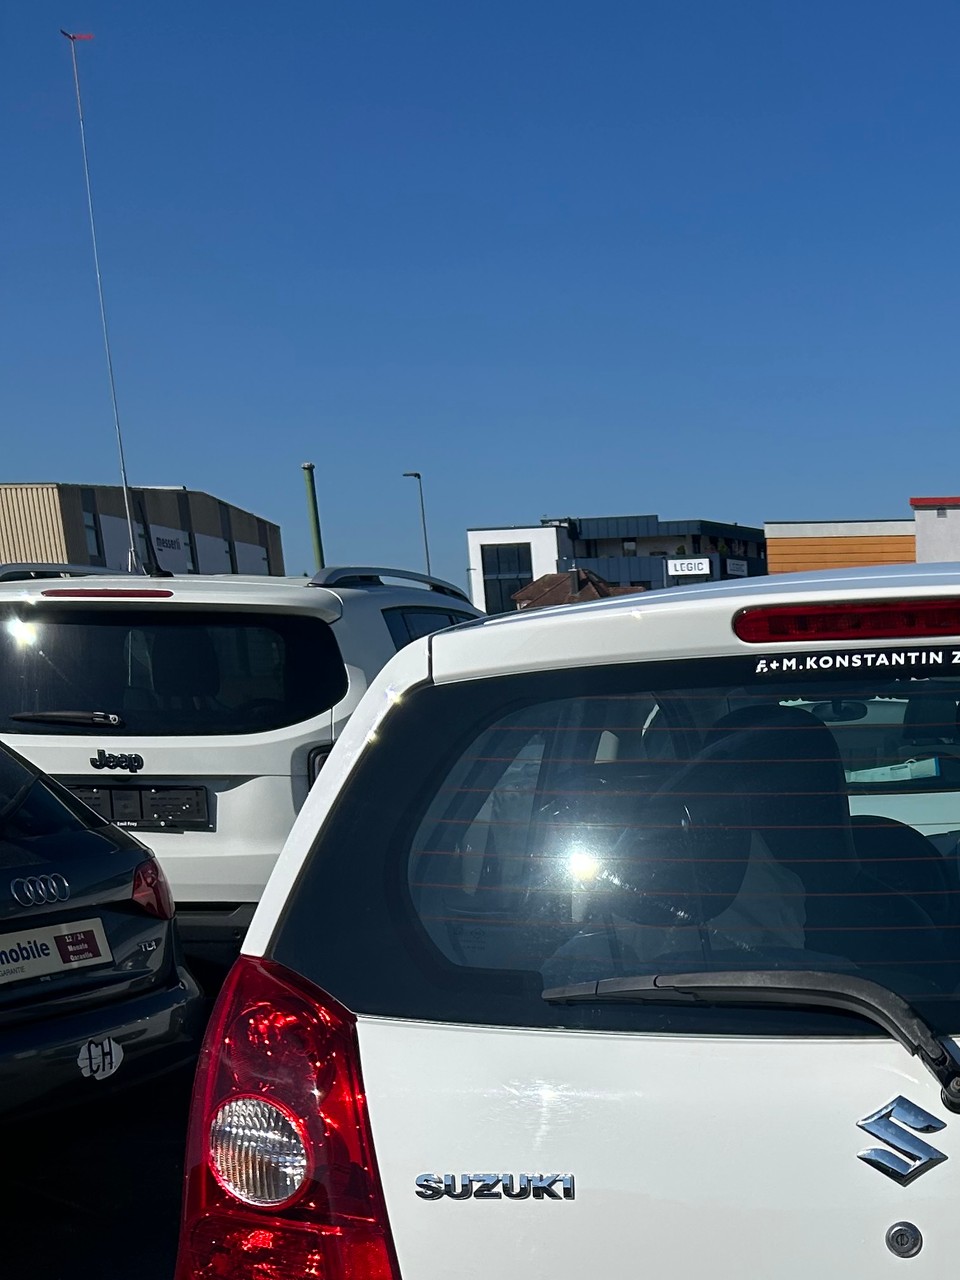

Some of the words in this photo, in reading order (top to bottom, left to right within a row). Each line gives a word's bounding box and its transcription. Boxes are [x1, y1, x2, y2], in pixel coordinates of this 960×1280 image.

[674, 562, 704, 572] LEGIC
[89, 749, 144, 773] Jeep
[87, 1037, 114, 1074] CH
[414, 1172, 576, 1201] SUZUKI
